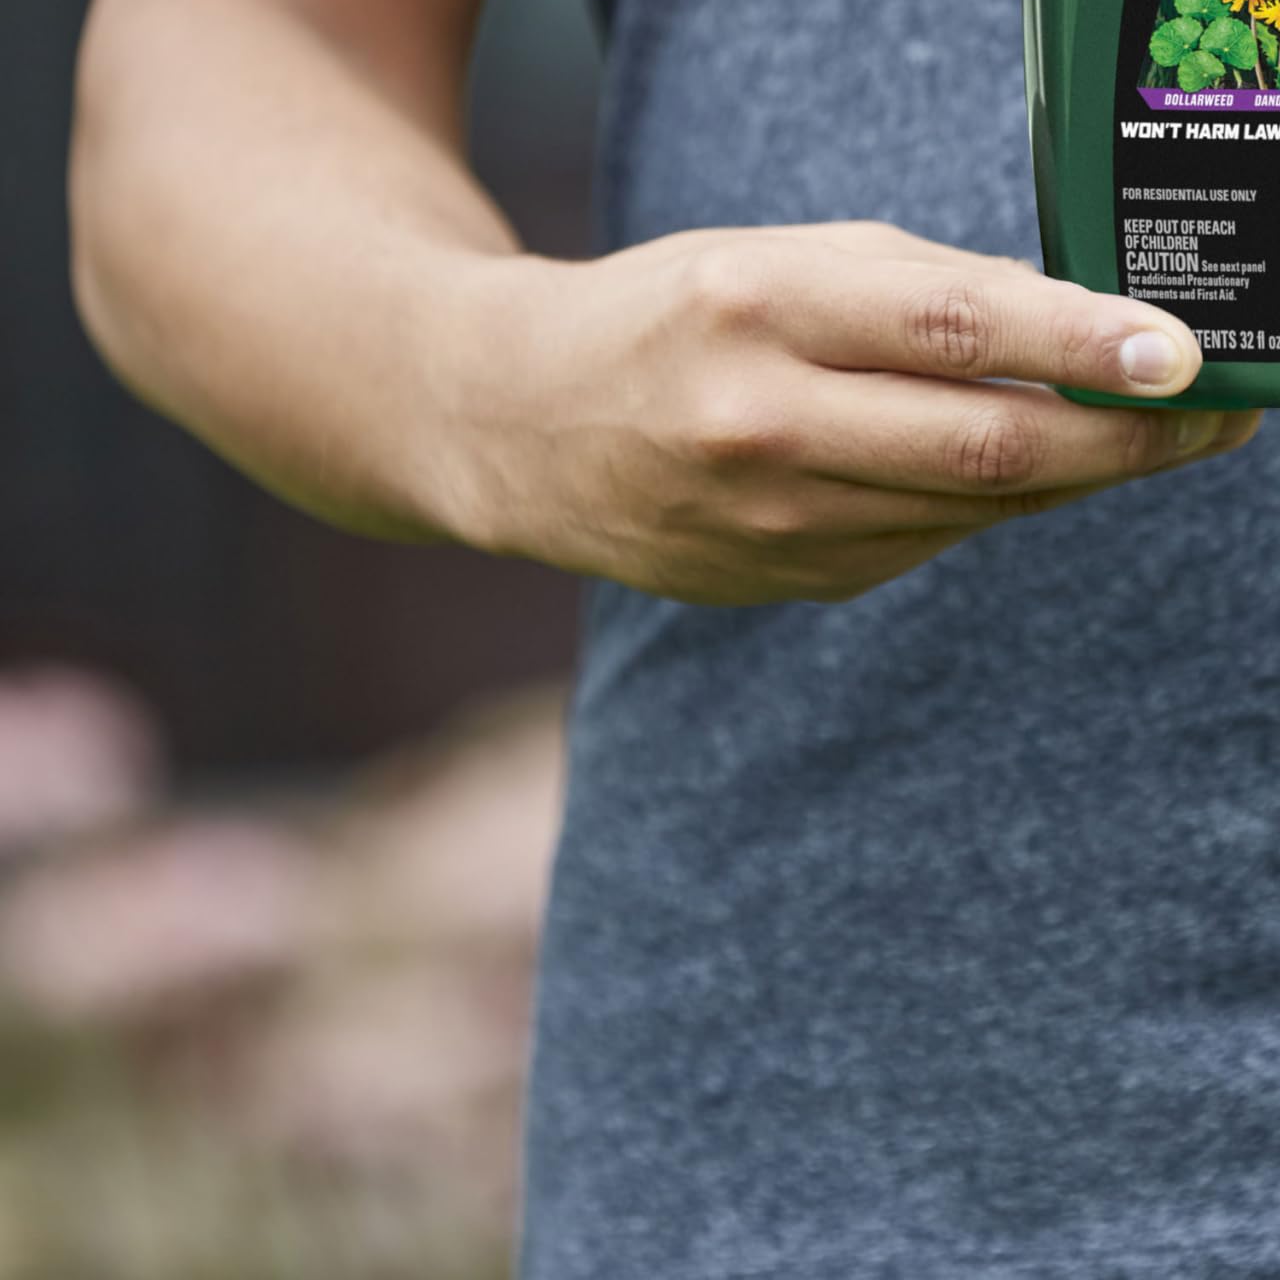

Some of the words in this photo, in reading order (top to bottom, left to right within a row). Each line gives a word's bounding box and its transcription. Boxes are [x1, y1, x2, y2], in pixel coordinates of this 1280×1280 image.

[1164, 93, 1234, 107] DOLLARWEED
[1185, 124, 1239, 140] HARM
[1123, 188, 1142, 200] FOR
[1144, 189, 1208, 201] RESIDENTIAL
[1210, 189, 1229, 201] USE
[1231, 190, 1257, 202] ONLY
[1124, 219, 1152, 233] KEEP
[1156, 220, 1178, 234] OUT
[1181, 220, 1196, 234] OF
[1197, 220, 1235, 235] REACH
[1125, 235, 1140, 249] OF
[1142, 236, 1198, 250] CHILDREN
[1126, 252, 1199, 272] CAUTION
[1202, 260, 1219, 272] See
[1220, 263, 1240, 272] next
[1242, 261, 1265, 275] panel
[1128, 273, 1140, 284] for
[1142, 273, 1185, 285] additional
[1188, 275, 1250, 289] Precautionary
[1128, 287, 1178, 300] Statements
[1180, 289, 1196, 300] and
[1197, 289, 1217, 300] First
[1219, 289, 1237, 301] Aid.
[1240, 330, 1254, 350] 32
[1257, 330, 1265, 350] fl
